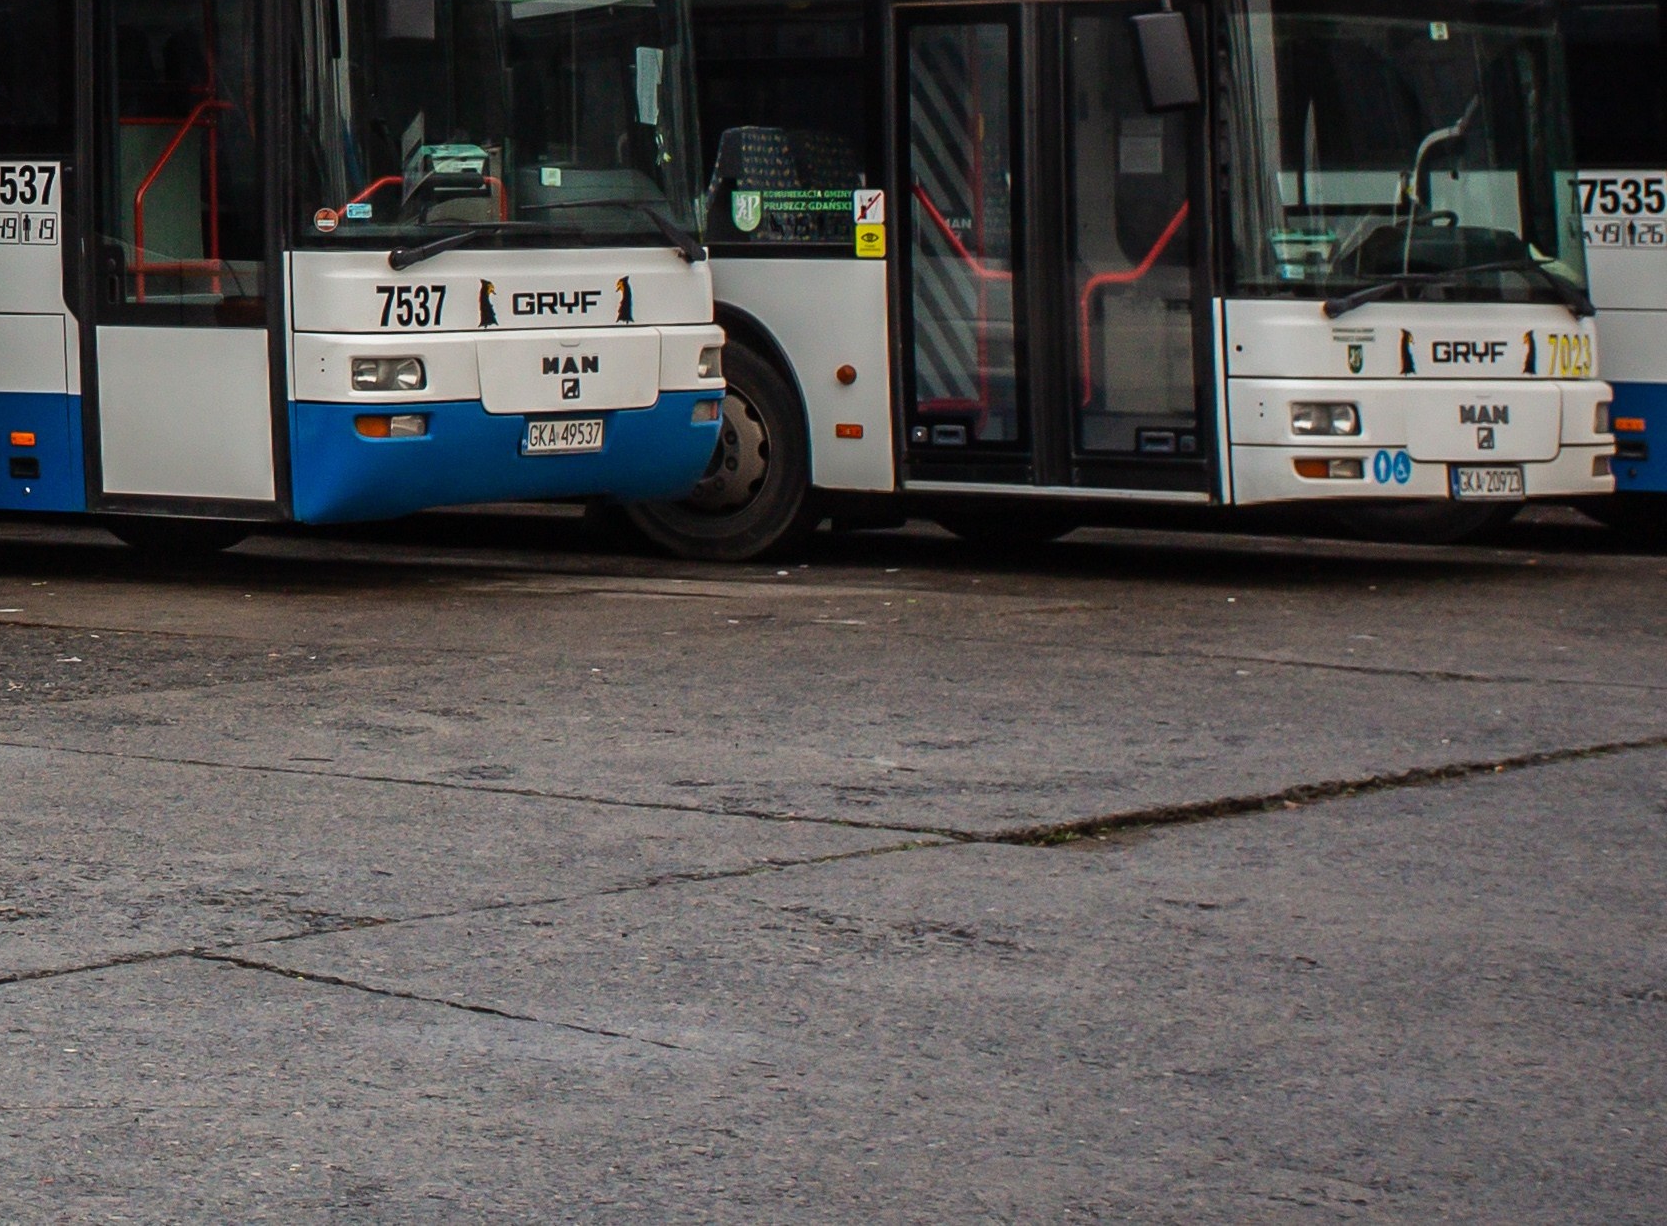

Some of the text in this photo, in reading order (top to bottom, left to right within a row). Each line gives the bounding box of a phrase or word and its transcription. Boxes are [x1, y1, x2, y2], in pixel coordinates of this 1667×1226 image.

[763, 198, 853, 211] PRUSZCZ GDAŃSKI
[1578, 178, 1666, 214] 7535
[1594, 223, 1620, 243] 49
[375, 284, 447, 326] 7537
[512, 290, 602, 316] GRYF
[1431, 340, 1508, 364] GRYF
[1547, 332, 1593, 377] 7023
[541, 355, 599, 376] MAN
[1459, 404, 1509, 425] MAN
[528, 422, 602, 448] GKA 49537
